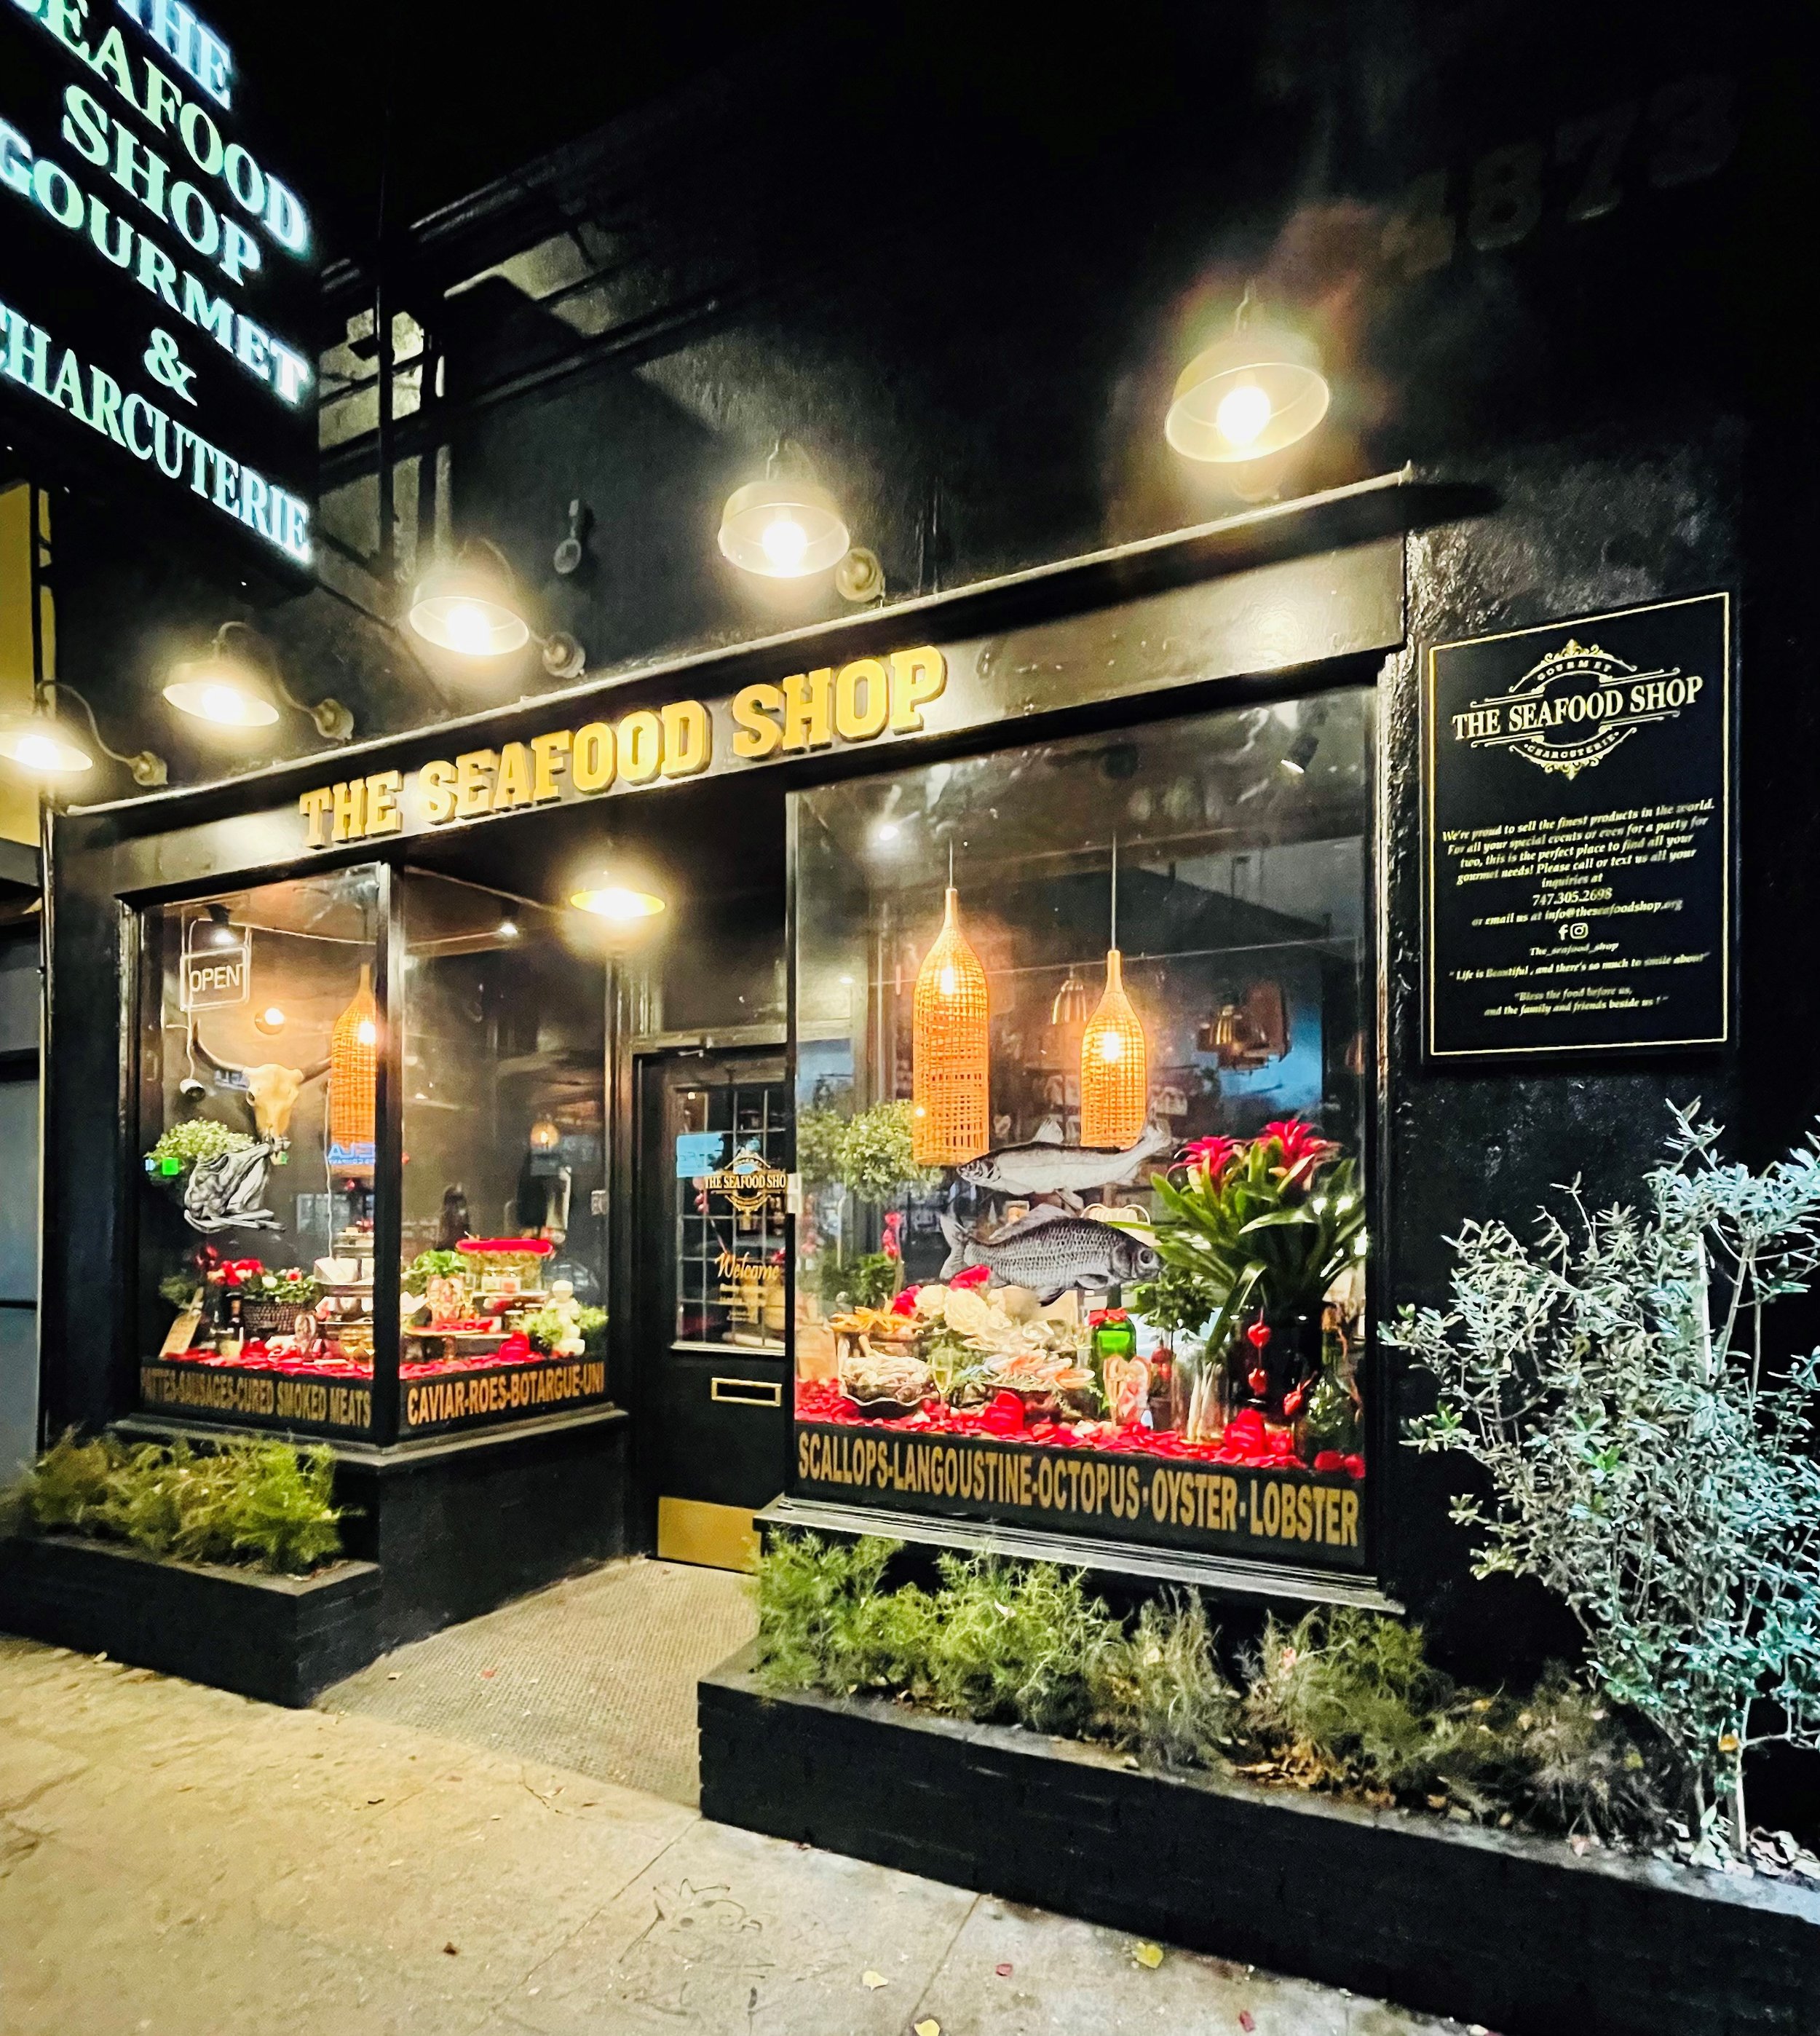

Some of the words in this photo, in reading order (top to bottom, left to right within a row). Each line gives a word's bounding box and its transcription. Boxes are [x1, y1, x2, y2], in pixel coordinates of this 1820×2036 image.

[10, 0, 309, 253] EAFOOD
[61, 84, 263, 287] SHOP
[0, 117, 308, 404] GOURMET
[143, 328, 197, 406] &
[0, 299, 312, 564] HARCUTERIE
[1538, 660, 1612, 681] GOURMET
[1452, 709, 1501, 741] THE
[1508, 690, 1624, 732] SEAFOOD
[1630, 676, 1704, 714] SHOP
[299, 770, 403, 850] THE
[418, 699, 712, 825] SEAFOOD
[732, 645, 948, 761] SHOP
[1442, 829, 1470, 842] We're
[1471, 825, 1502, 840] proud
[1504, 825, 1515, 834] to
[1517, 820, 1537, 832] sell
[1539, 819, 1556, 830] the
[1556, 816, 1588, 831] finest
[1590, 810, 1638, 827] products
[1641, 808, 1653, 817] in
[1655, 805, 1674, 816] the
[1676, 798, 1714, 813] world.
[1447, 845, 1465, 856] For
[1467, 841, 1481, 853] all
[1483, 841, 1508, 854] your
[1509, 834, 1546, 850] special
[1548, 832, 1582, 844] events
[1584, 830, 1597, 840] or
[1599, 826, 1625, 837] even
[1626, 824, 1644, 837] for
[1645, 824, 1653, 832] a
[1655, 819, 1688, 834] party
[1690, 816, 1709, 829] for
[1456, 869, 1498, 885] gourmet
[1501, 864, 1534, 878] needs!
[1537, 862, 1571, 874] Please
[1572, 858, 1594, 870] call
[1596, 858, 1608, 868] or
[1610, 854, 1633, 867] text
[1634, 855, 1648, 864] us
[1650, 850, 1666, 862] all
[1669, 849, 1697, 863] your
[1460, 858, 1483, 868] two,
[1486, 854, 1506, 865] this
[1507, 853, 1517, 863] is
[1519, 851, 1536, 861] the
[1538, 846, 1575, 862] perfect
[1575, 844, 1606, 859] place
[1607, 842, 1620, 851] to
[1620, 837, 1645, 853] find
[1647, 834, 1664, 847] all
[1666, 833, 1694, 848] your
[1532, 887, 1613, 907] 747.305.2698
[1542, 875, 1589, 889] inquiries
[1591, 873, 1603, 883] at
[1471, 918, 1483, 926] or
[1485, 912, 1514, 925] email
[1516, 914, 1528, 923] us
[1530, 912, 1543, 921] at
[189, 965, 241, 992] OPEN
[1476, 969, 1484, 979] is
[1535, 963, 1554, 974] and
[1588, 962, 1600, 971] so
[1602, 958, 1629, 969] much
[1631, 958, 1642, 967] to
[1484, 1006, 1502, 1017] and
[1503, 1005, 1518, 1015] the
[1519, 1003, 1552, 1017] family
[1552, 1001, 1572, 1012] and
[1572, 1000, 1607, 1014] friends
[1609, 998, 1639, 1009] beside
[1642, 999, 1653, 1007] us
[1546, 989, 1561, 999] the
[1562, 987, 1586, 1001] food
[705, 1174, 722, 1189] THE
[724, 1173, 766, 1189] SEAFOOD
[767, 1173, 786, 1189] SHO
[714, 1251, 780, 1281] Welcome
[277, 1381, 327, 1421] SMOKED
[330, 1386, 371, 1428] MEATS
[799, 1431, 887, 1489] SCALLOPS
[1038, 1456, 1140, 1520] OCTOPUS
[1152, 1469, 1237, 1532] OYSTER
[1250, 1480, 1359, 1547] LOBSTER
